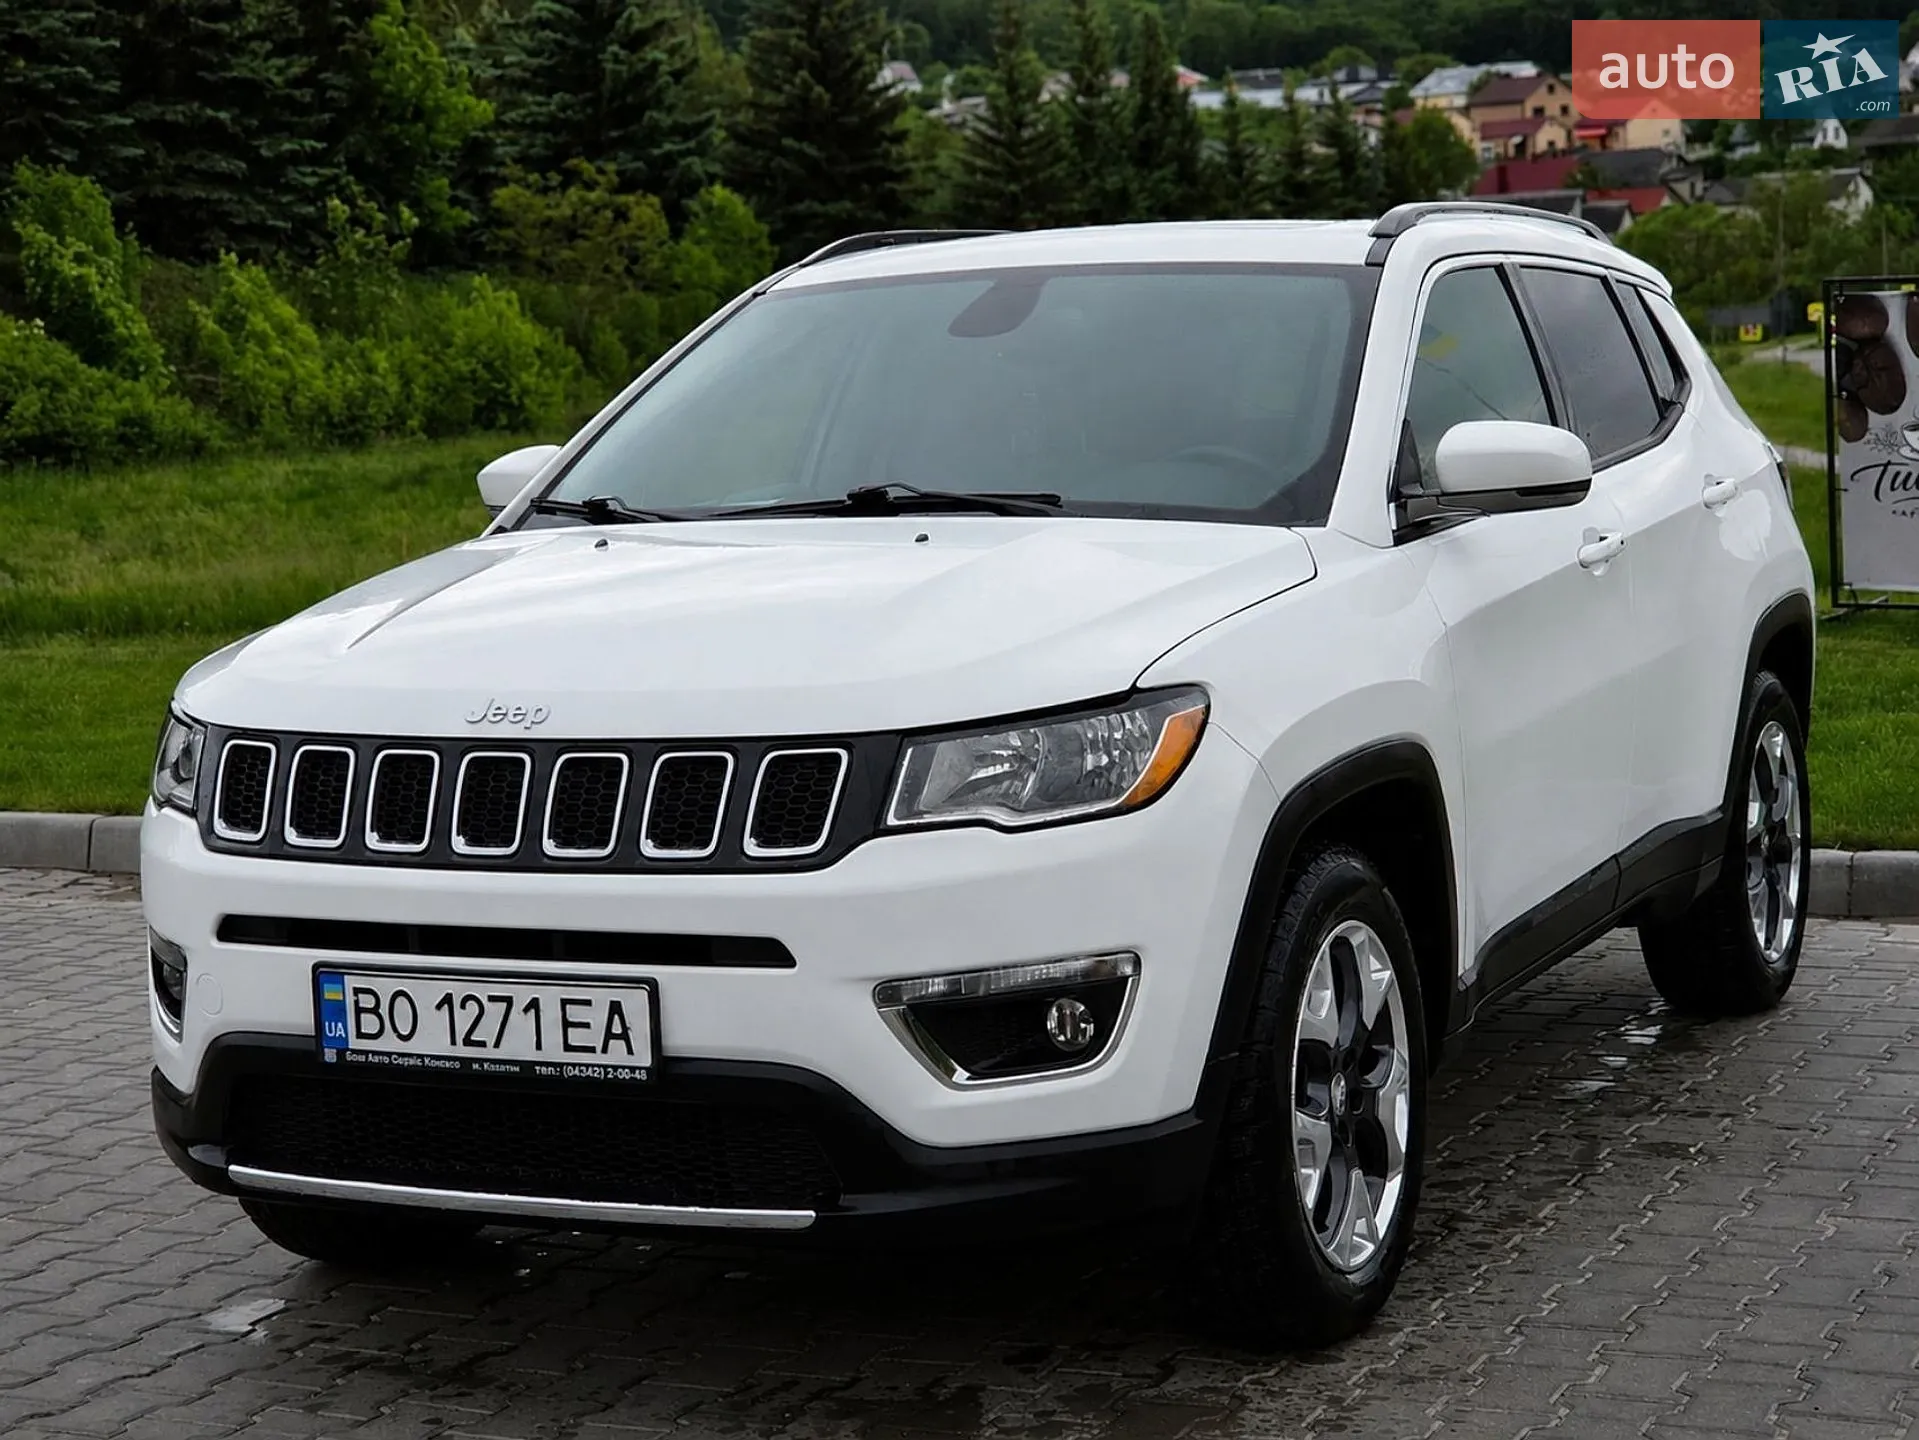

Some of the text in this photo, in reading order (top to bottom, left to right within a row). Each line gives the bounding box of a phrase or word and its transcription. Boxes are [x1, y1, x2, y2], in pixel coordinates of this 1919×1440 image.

[464, 698, 552, 730] Jeep
[325, 1021, 346, 1039] UA
[352, 986, 635, 1056] BO 1271 EA
[563, 1065, 605, 1080] (04342)
[606, 1068, 648, 1081] 2-00-48
